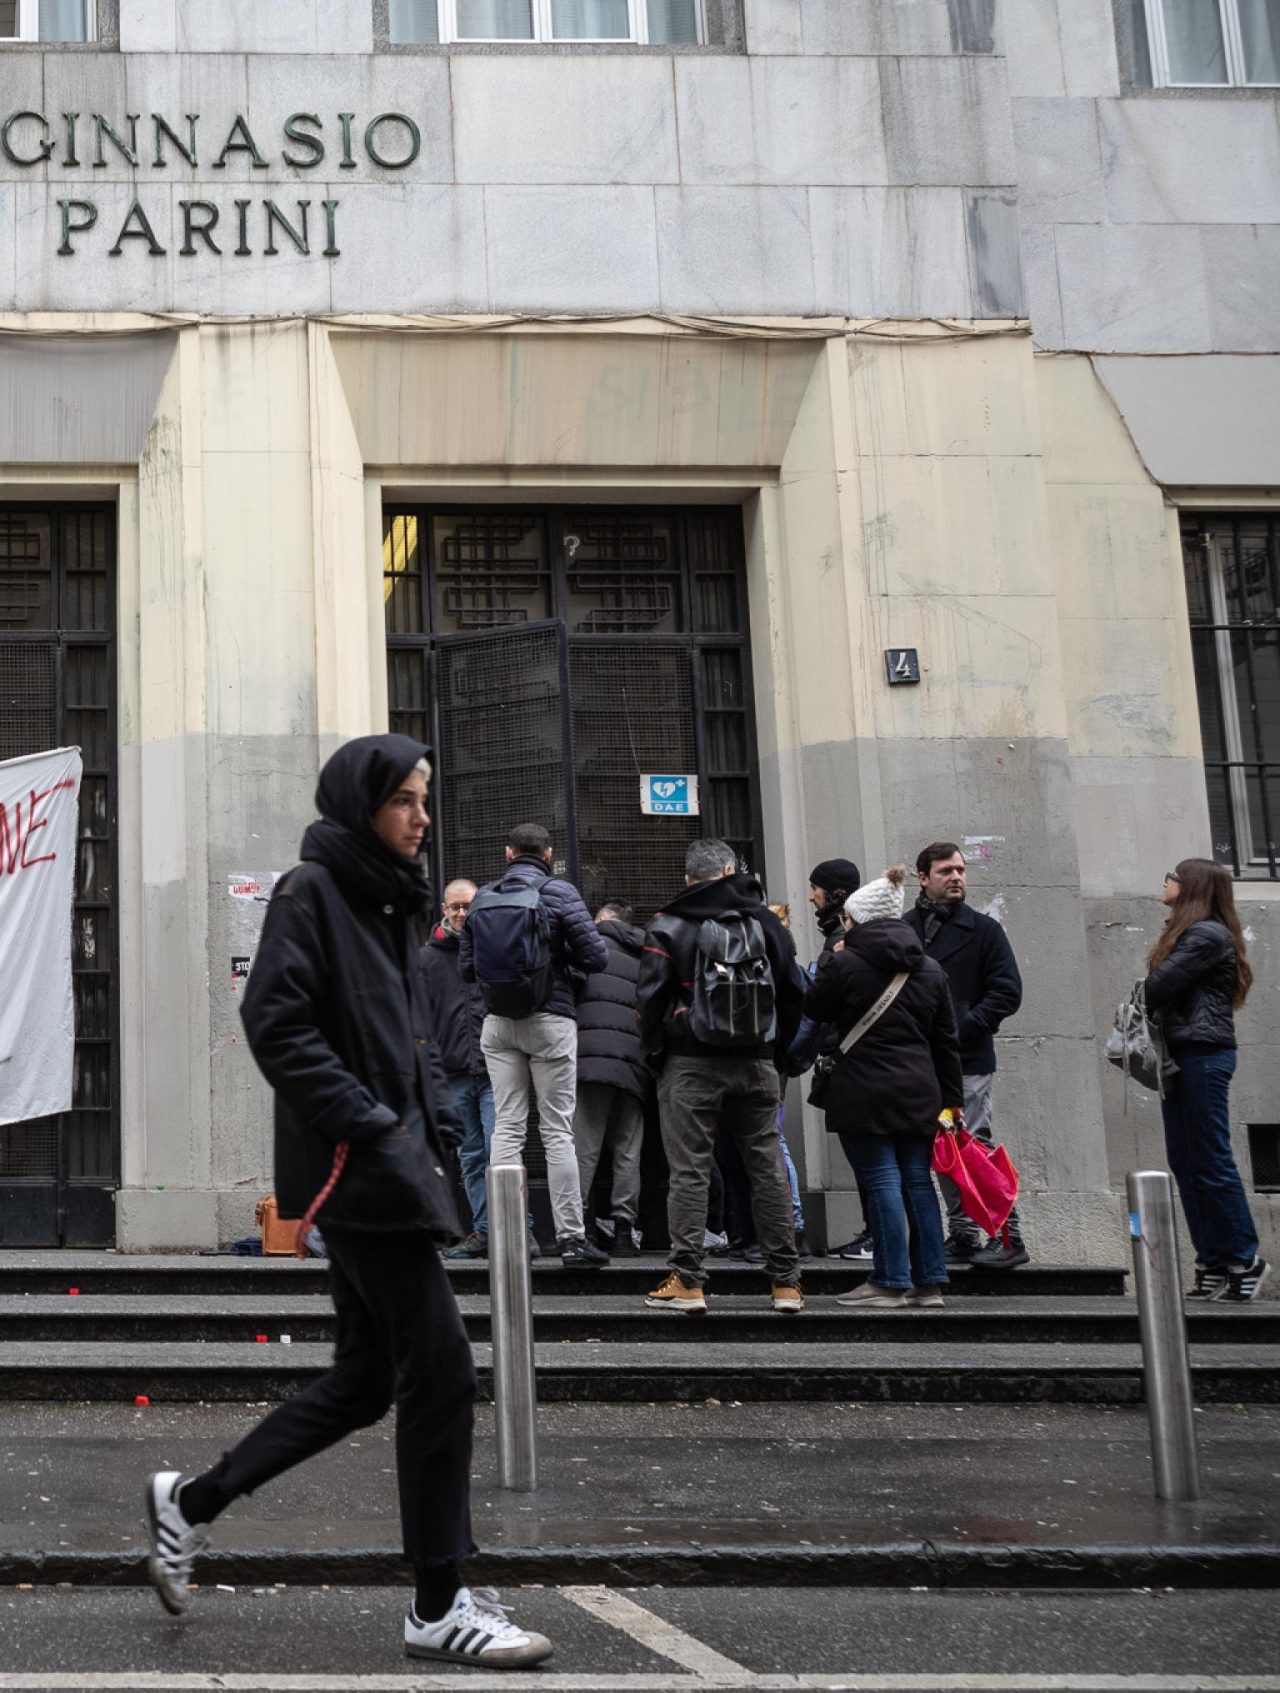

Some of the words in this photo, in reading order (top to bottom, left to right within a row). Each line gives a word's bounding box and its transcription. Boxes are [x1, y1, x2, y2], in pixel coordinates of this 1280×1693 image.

[0, 110, 421, 169] GINNASIO
[57, 199, 341, 256] PARINI
[895, 652, 911, 677] 4
[654, 803, 684, 812] DAE
